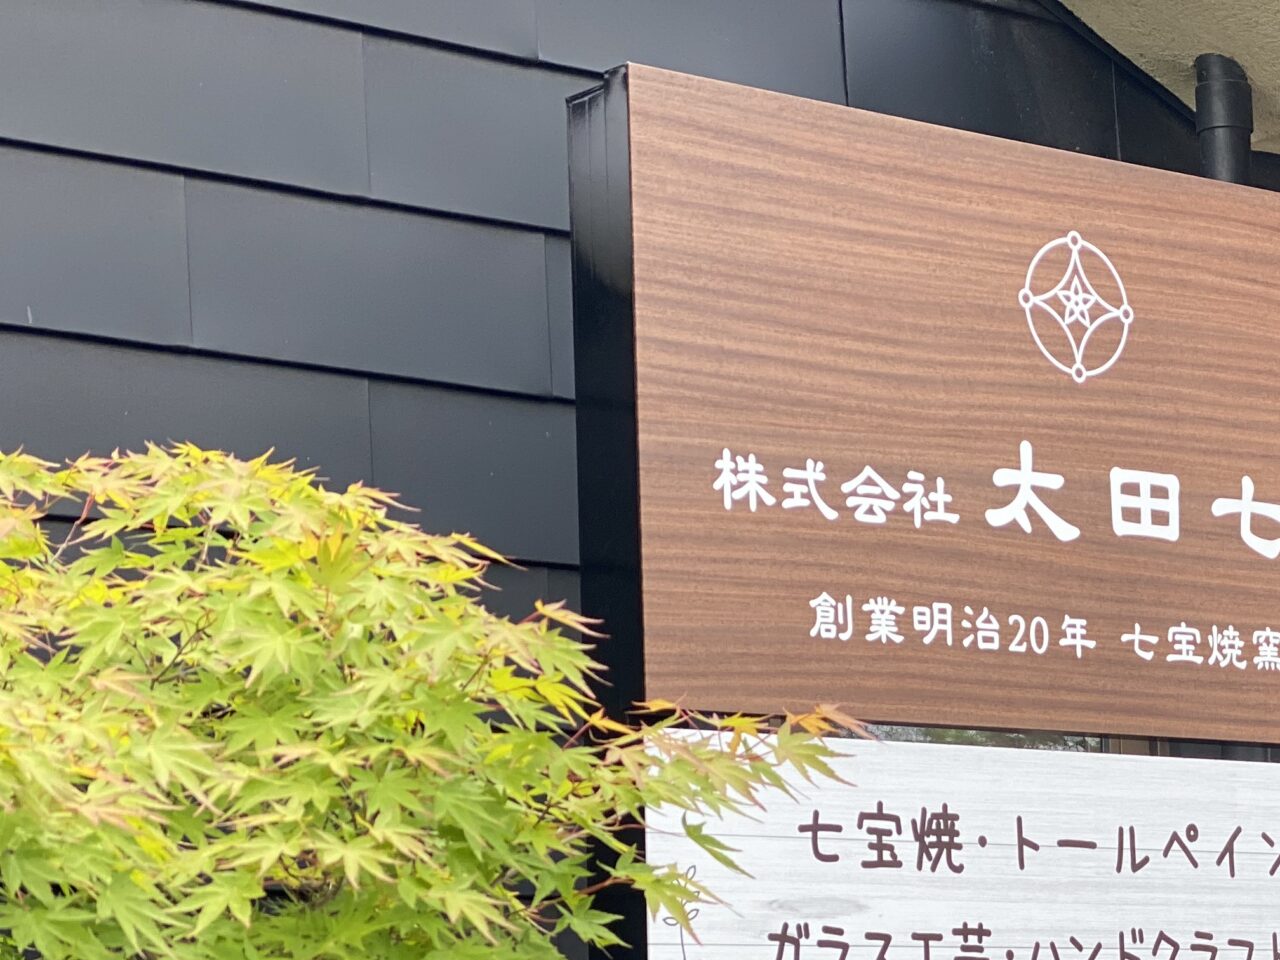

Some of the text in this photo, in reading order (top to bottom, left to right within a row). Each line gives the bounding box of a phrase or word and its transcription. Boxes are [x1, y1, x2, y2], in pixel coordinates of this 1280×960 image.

[712, 447, 961, 529] 株式会社
[808, 591, 1097, 659] 創業明治20年
